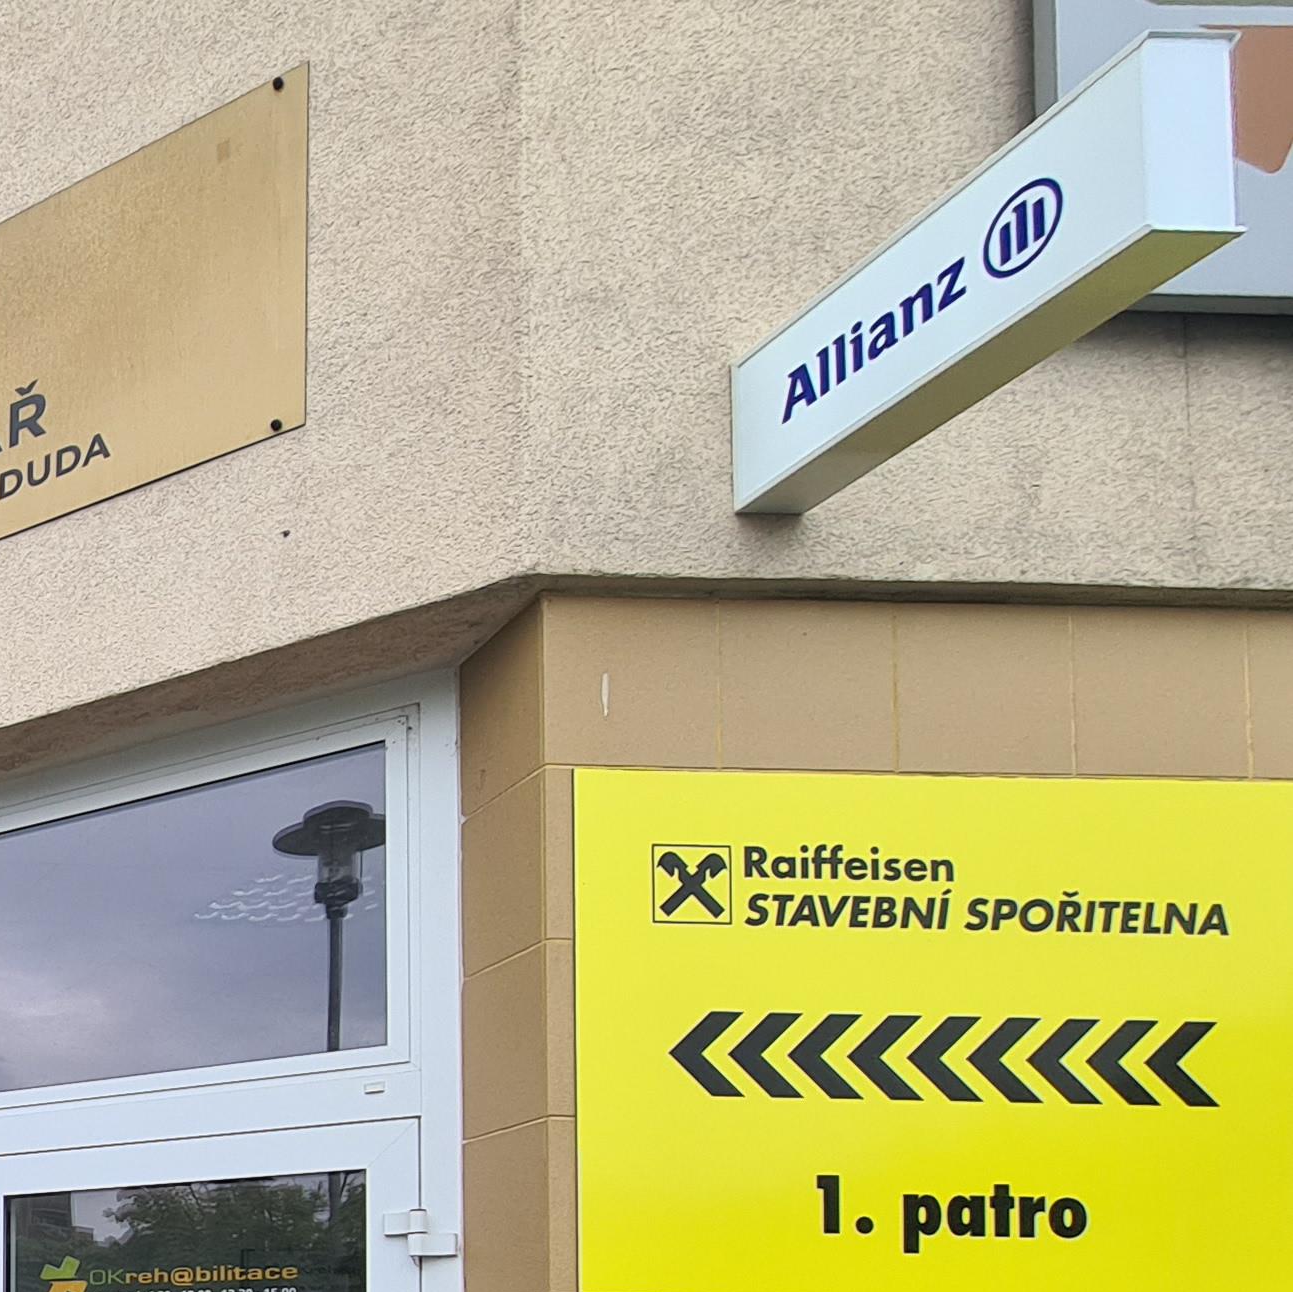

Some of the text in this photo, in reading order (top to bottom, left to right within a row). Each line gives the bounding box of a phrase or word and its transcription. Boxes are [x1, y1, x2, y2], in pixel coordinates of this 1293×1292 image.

[782, 256, 966, 424] Allianz
[743, 845, 955, 882] Raiffeisen
[744, 888, 1230, 936] STAVEBNÍ SPOŘITELNA
[816, 1174, 1088, 1255] 1. patro
[89, 1264, 299, 1287] OKreh@bilitace
